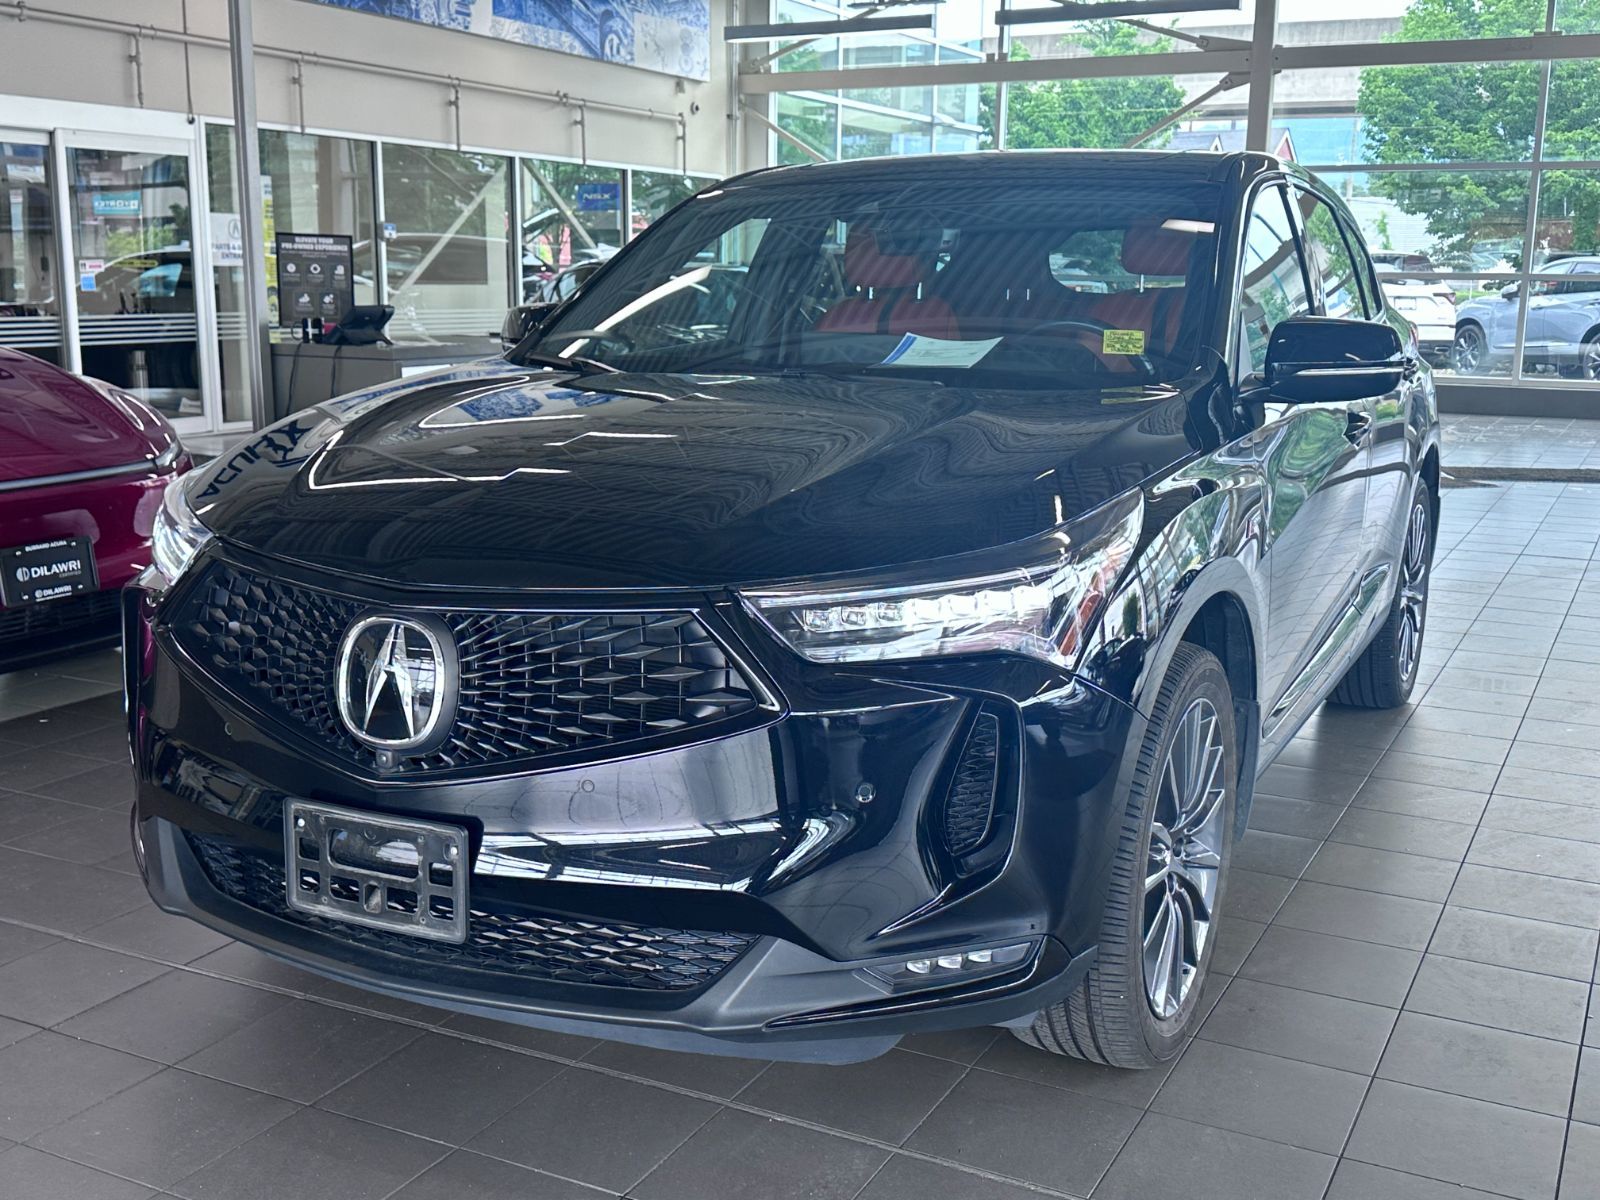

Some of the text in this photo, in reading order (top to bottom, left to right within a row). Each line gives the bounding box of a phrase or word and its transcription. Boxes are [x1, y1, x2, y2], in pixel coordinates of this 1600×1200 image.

[50, 540, 67, 548] ACURA
[31, 560, 81, 578] DILAWRI
[43, 585, 72, 597] DILAWRI
